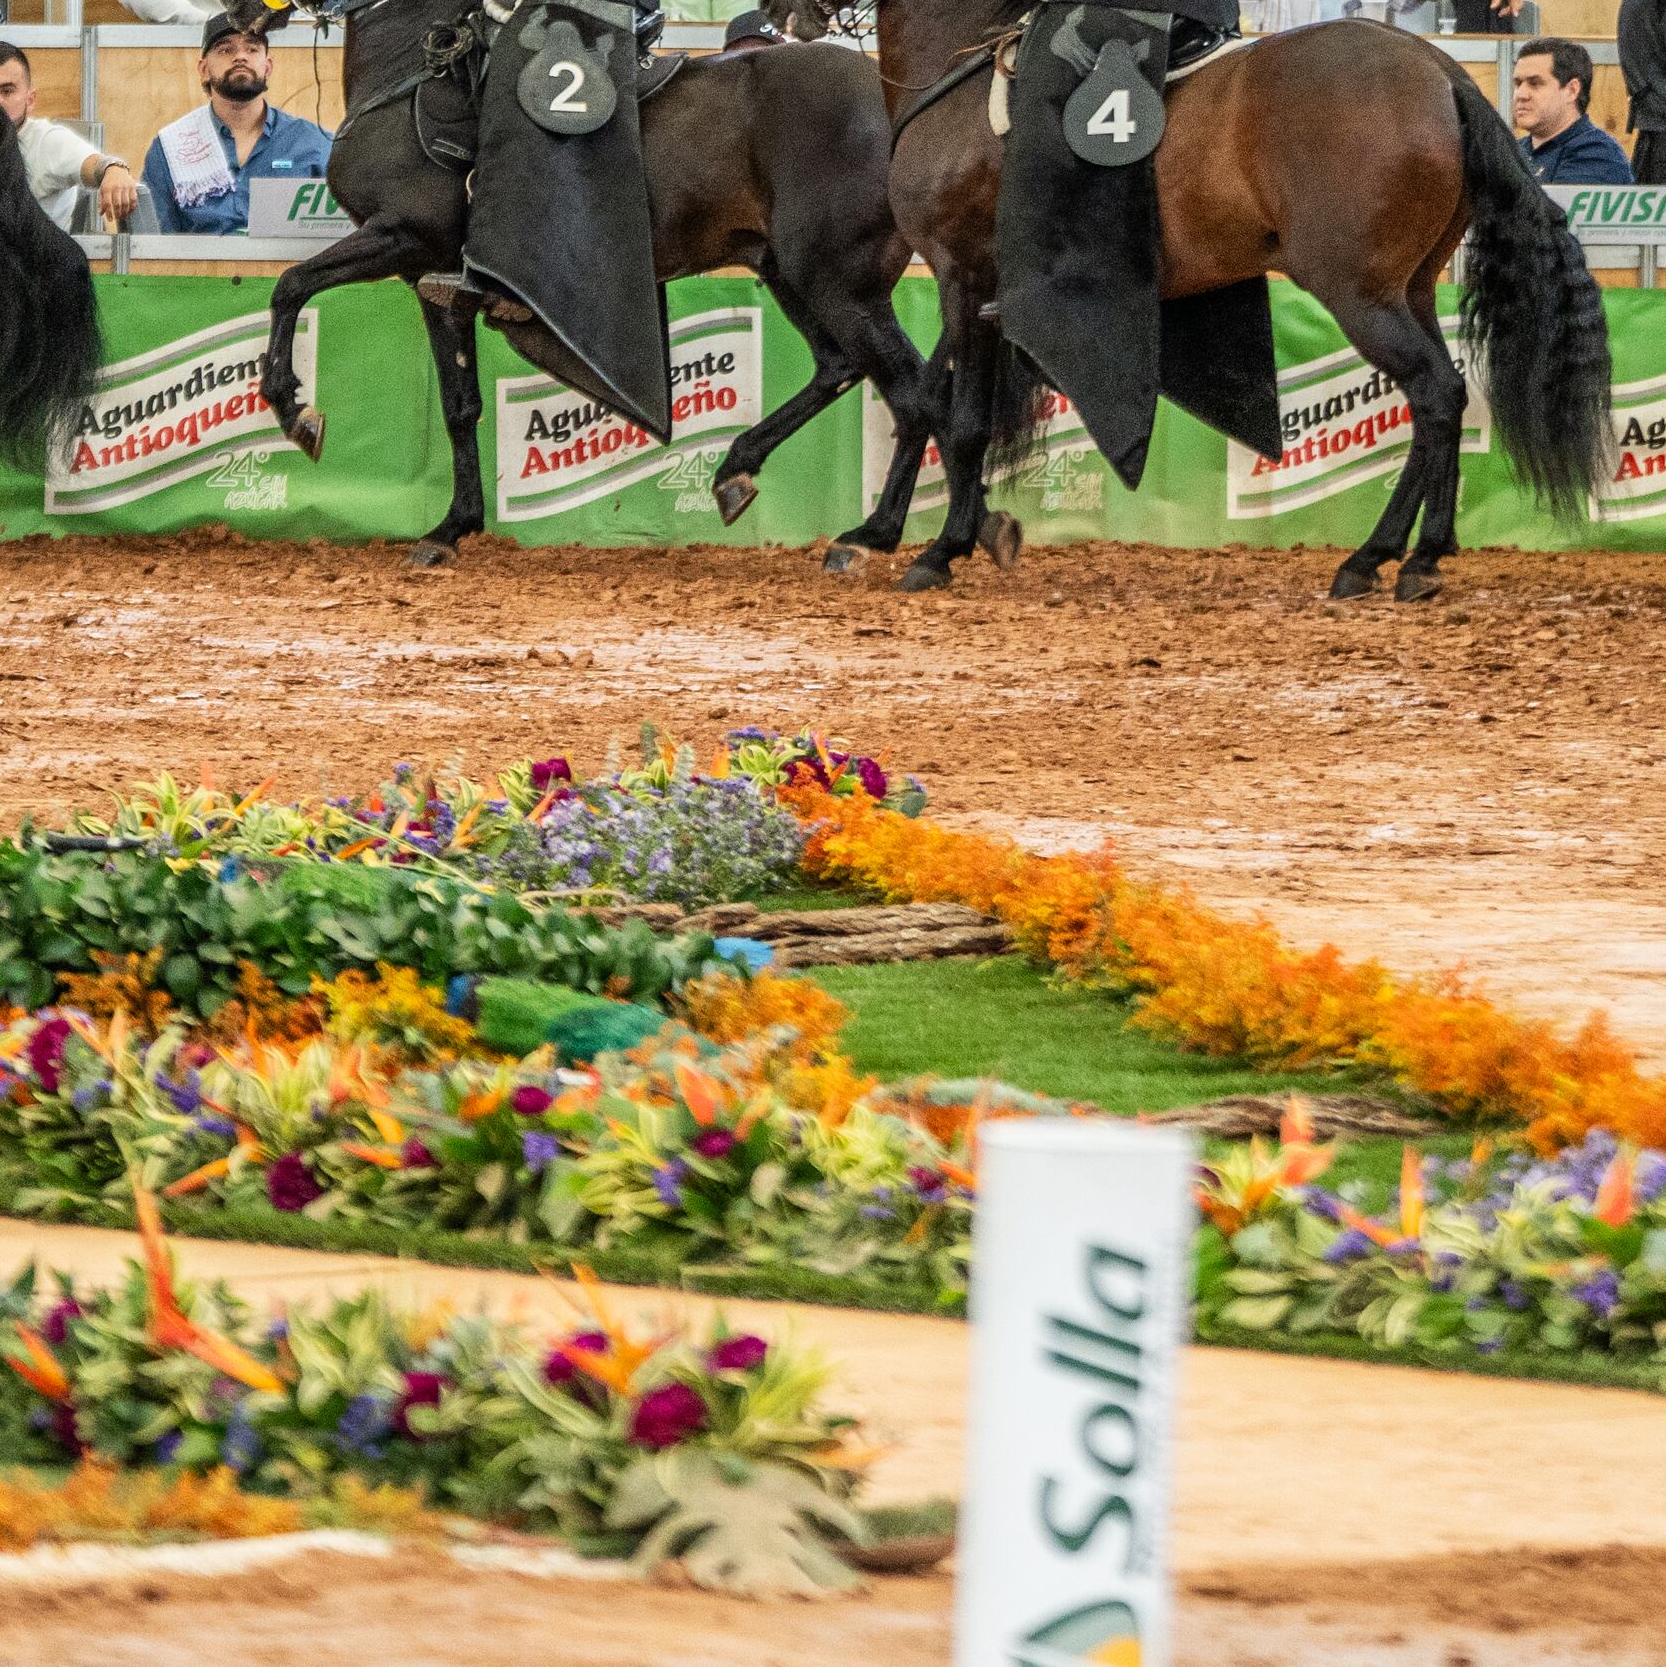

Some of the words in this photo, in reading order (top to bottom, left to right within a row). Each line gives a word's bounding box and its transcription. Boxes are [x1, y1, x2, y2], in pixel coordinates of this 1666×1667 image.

[548, 61, 588, 113] 2
[1086, 89, 1137, 143] 4
[70, 380, 271, 474] Antioqueñ
[205, 451, 271, 489] 24°
[1036, 1242, 1148, 1577] Solla
